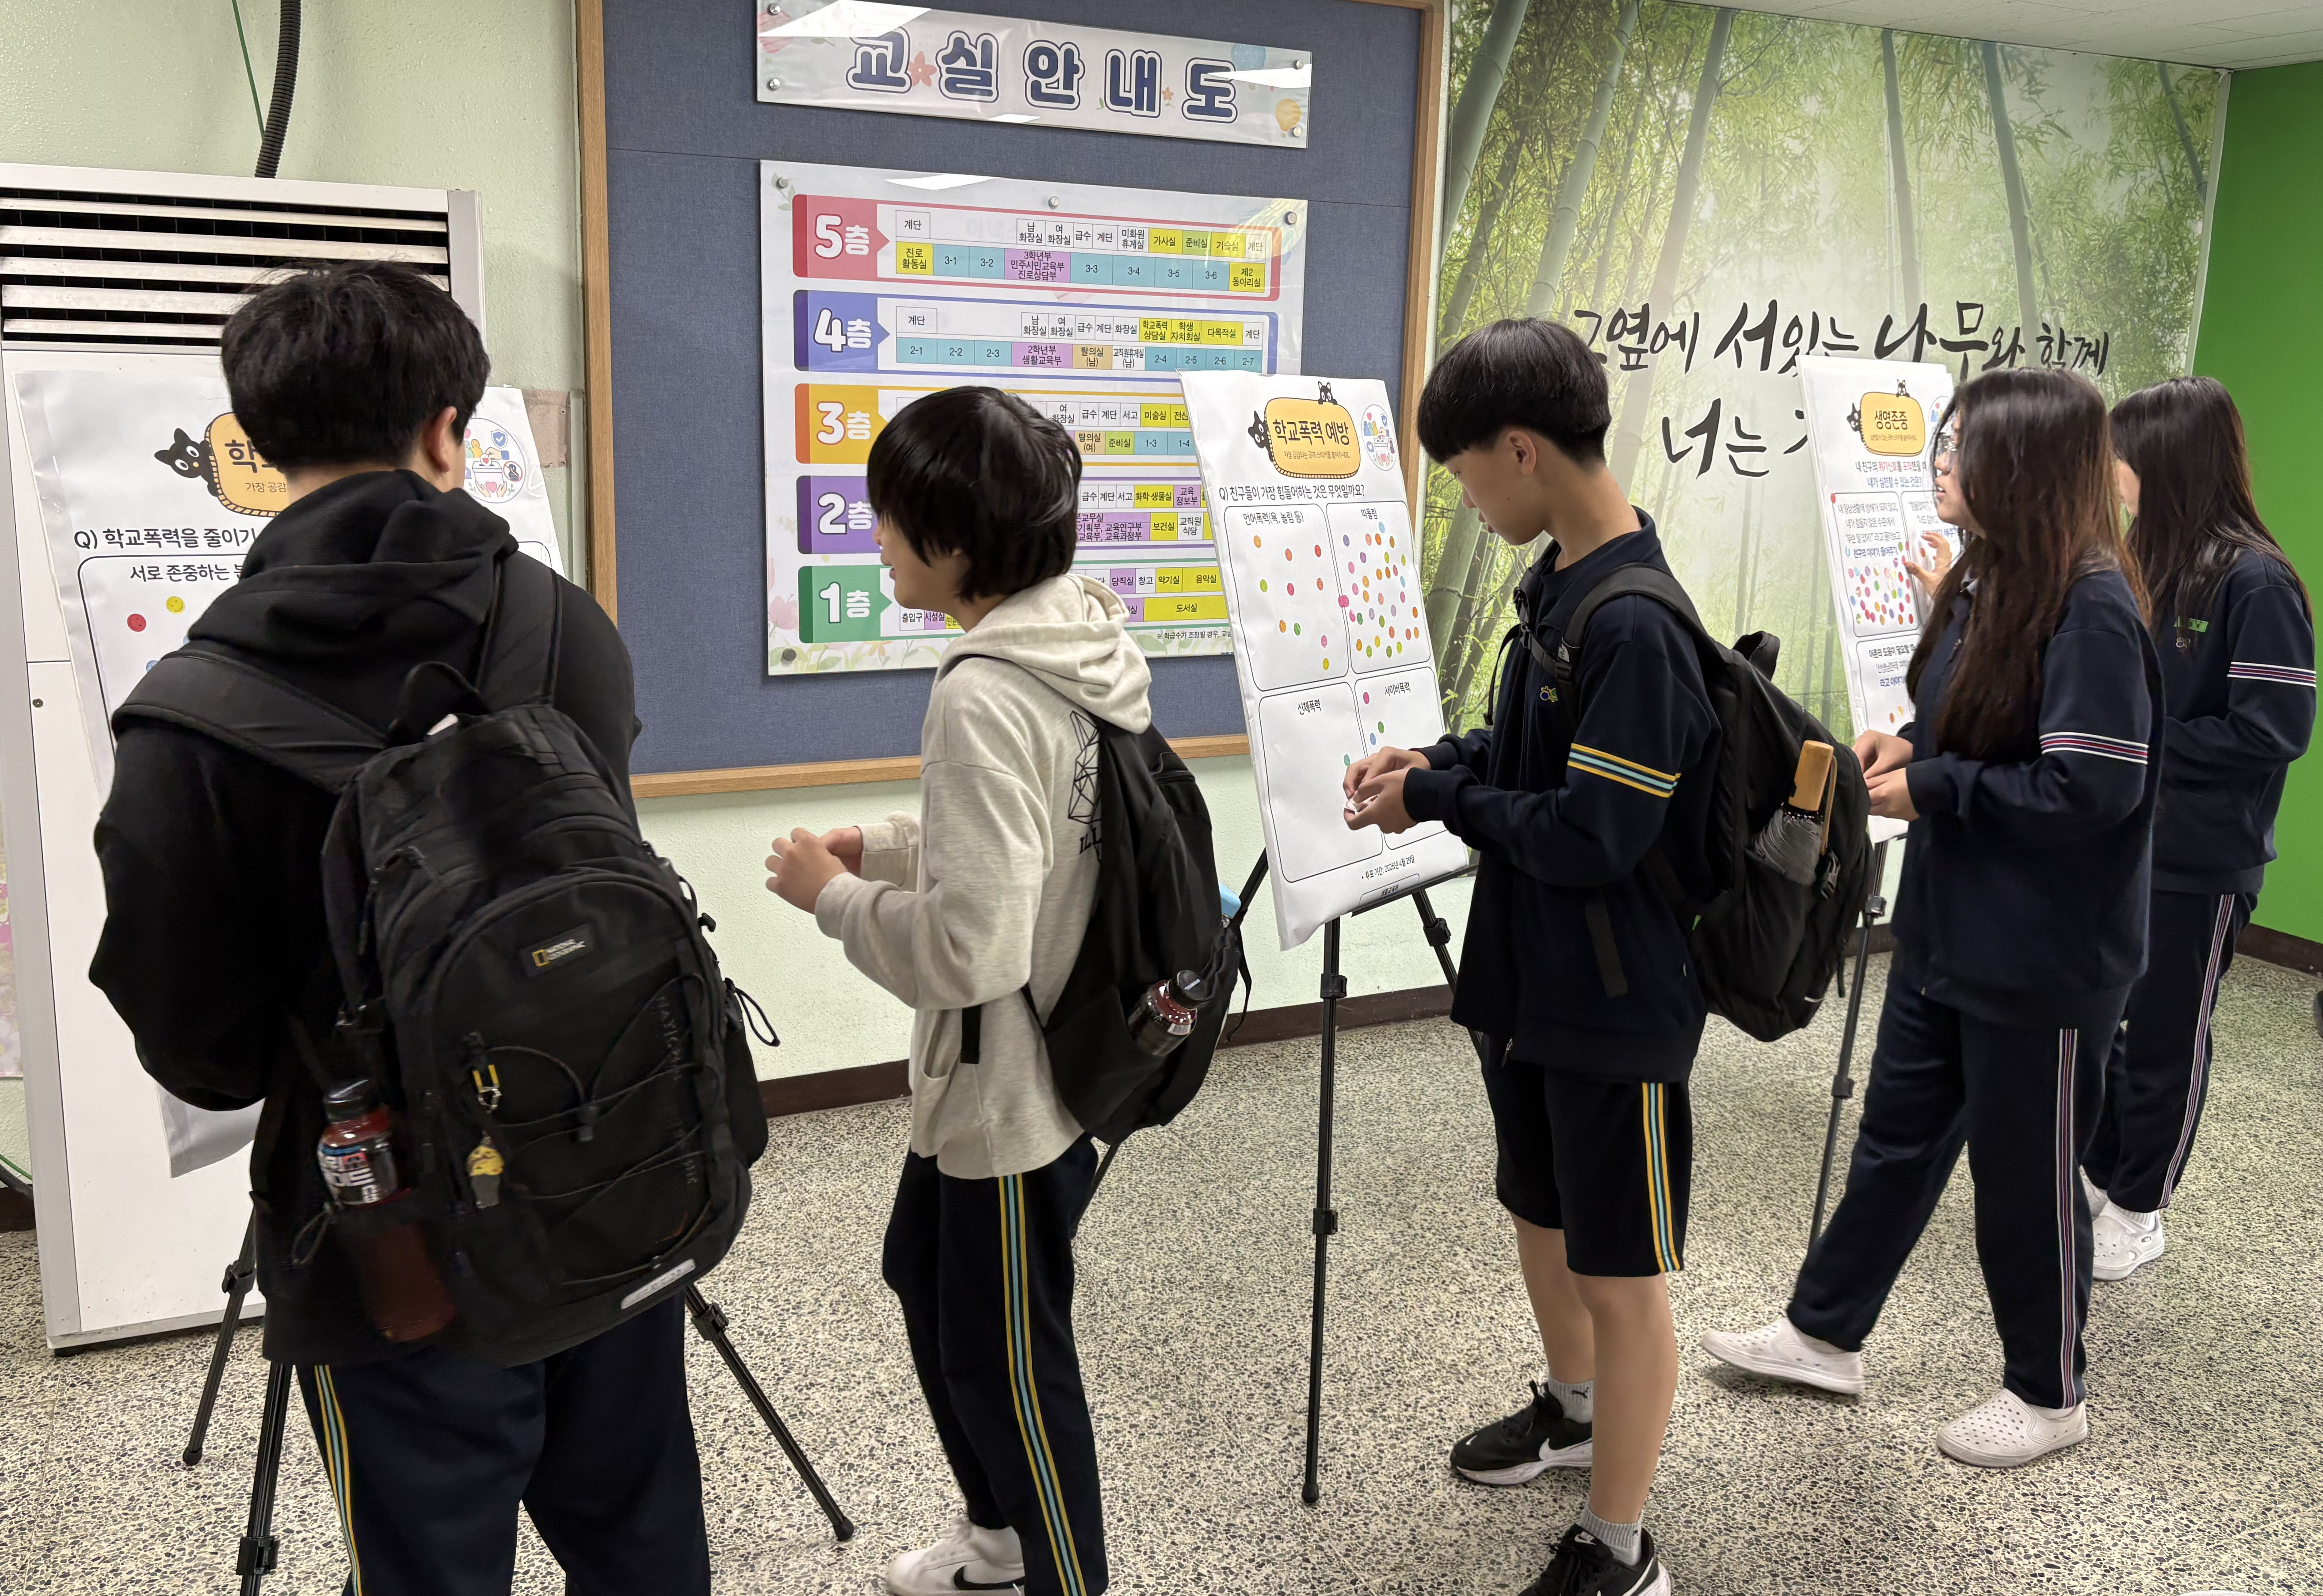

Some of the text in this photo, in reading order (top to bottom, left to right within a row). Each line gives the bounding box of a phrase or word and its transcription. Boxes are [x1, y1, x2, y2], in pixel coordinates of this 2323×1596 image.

[904, 219, 922, 230] 계단
[1028, 222, 1035, 232] 남
[1056, 224, 1063, 233] 여
[814, 213, 870, 260] 5층
[1019, 233, 1042, 243] 화장실
[1076, 230, 1091, 241] 급수
[1097, 233, 1113, 242] 계단
[1122, 228, 1144, 239] 미화원
[1047, 234, 1070, 245] 화장실
[1122, 239, 1144, 249] 휴게실
[1154, 236, 1175, 246] 가사실
[1186, 238, 1207, 248] 준비실
[1248, 242, 1263, 252] 계단
[905, 248, 923, 258] 진로
[1024, 251, 1052, 261] 3학년부
[902, 259, 927, 269] 활동실
[944, 256, 957, 265] 3-1
[980, 258, 993, 267] 3-2
[1011, 260, 1065, 272] 민주시민교육부
[1086, 264, 1098, 273] 3-3
[1128, 267, 1140, 275] 3-4
[1018, 270, 1057, 281] 진로상담부
[1168, 269, 1180, 278] 3-5
[1205, 271, 1217, 279] 3-6
[1241, 267, 1253, 277] 제2
[1232, 277, 1260, 287] 동아리실
[908, 315, 925, 326] 계단
[1031, 315, 1039, 325] 남
[1058, 316, 1065, 326] 여
[1143, 320, 1167, 330] 학교폭력
[813, 307, 872, 352] 4층
[1023, 325, 1046, 336] 화장실
[1050, 327, 1073, 337] 화장실
[1077, 322, 1093, 333] 급수
[1096, 323, 1112, 333] 계단
[1115, 324, 1137, 334] 화장실
[1179, 322, 1194, 332] 학생
[1144, 331, 1166, 340] 상담실
[1171, 332, 1201, 341] 자치회실
[1208, 328, 1236, 338] 다목적실
[1245, 329, 1260, 339] 계단
[910, 345, 923, 355] 2-1
[949, 347, 963, 356] 2-2
[987, 348, 999, 358] 2-3
[1028, 345, 1057, 355] 2학년부
[1081, 346, 1103, 357] 탈의실
[1022, 355, 1062, 366] 생활교육부
[1086, 357, 1099, 367] (남)
[1122, 358, 1135, 368] (남)
[1186, 356, 1197, 364] 2-5
[1060, 404, 1067, 413] 여
[1082, 409, 1097, 419] 급수
[1102, 410, 1117, 420] 계단
[1123, 410, 1138, 420] 서고
[1144, 411, 1166, 420] 미술실
[816, 401, 871, 445] 3층
[1874, 410, 1908, 430] 생명존중
[1273, 419, 1350, 446] 학교폭력 예방
[1079, 433, 1101, 443] 탈의실
[1109, 438, 1130, 448] 준비실
[1662, 397, 1770, 480] 너는
[1084, 443, 1096, 452] (여)
[245, 482, 264, 493] 가장
[1180, 487, 1194, 496] 교육
[1219, 487, 1228, 501] Q)
[1230, 486, 1260, 501] 친구들이
[1260, 486, 1275, 500] 가장
[1278, 485, 1312, 500] 힘들어하는
[1313, 485, 1327, 499] 것은
[1328, 484, 1365, 498] 무엇일까요?
[1082, 492, 1097, 501] 급수
[1100, 492, 1115, 501] 계단
[1118, 492, 1133, 501] 서고
[1176, 496, 1198, 506] 정보부
[818, 492, 872, 535] 2층
[1281, 512, 1294, 524] 놀림
[1294, 511, 1304, 523] 등)
[1361, 508, 1378, 520] 따돌림
[1152, 522, 1174, 531] 보건실
[1179, 517, 1201, 526] 교직원
[1105, 522, 1142, 532] 교육연구부
[1182, 527, 1198, 535] 식당
[74, 529, 98, 550] Q)
[102, 528, 199, 549] 학교폭력을
[1105, 532, 1142, 541] 교육과정부
[130, 565, 163, 582] 서로
[166, 564, 230, 582] 존중하는
[1111, 577, 1133, 586] 당직실
[1138, 577, 1153, 585] 창고
[1158, 575, 1179, 584] 악기실
[1196, 574, 1216, 584] 음악실
[819, 581, 870, 623] 1층
[1176, 603, 1197, 612] 도서실
[902, 613, 923, 622] 출입구
[1385, 681, 1411, 696] 사이버폭력
[1298, 699, 1321, 715] 신체폭력
